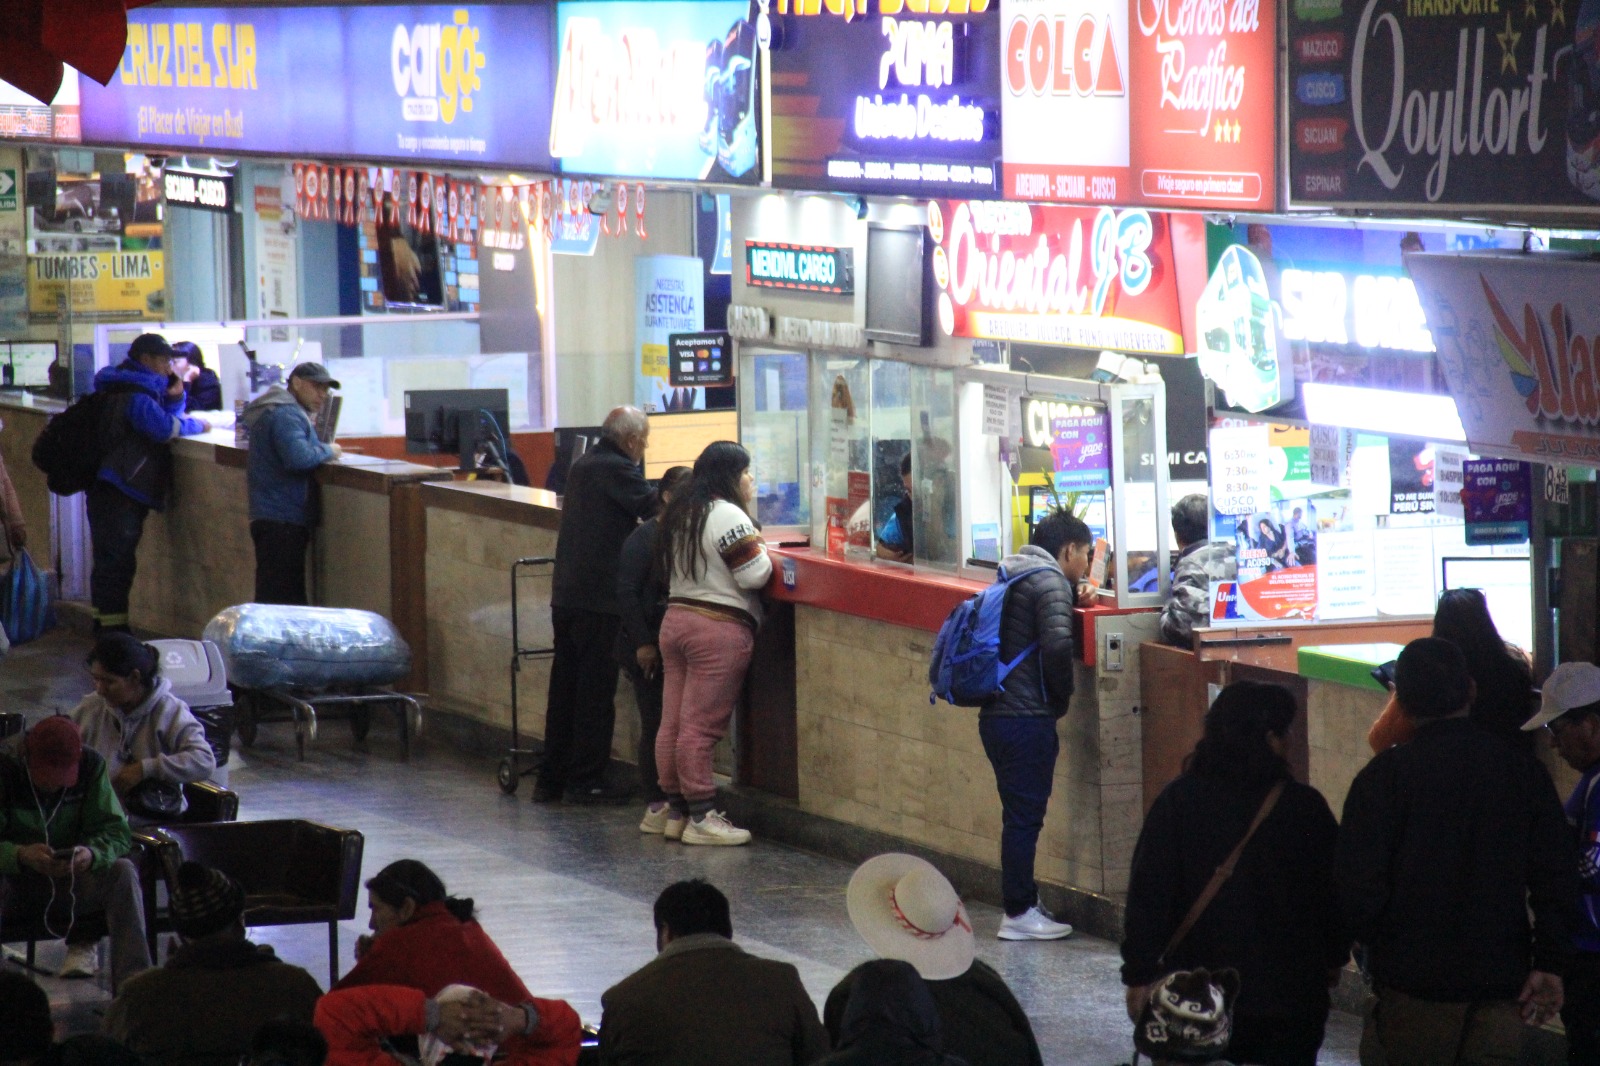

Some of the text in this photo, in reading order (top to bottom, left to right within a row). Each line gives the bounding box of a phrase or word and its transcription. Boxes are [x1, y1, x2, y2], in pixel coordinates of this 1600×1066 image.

[119, 23, 258, 90] CRUZ DEL SUR
[1007, 14, 1126, 97] COLCA
[1302, 41, 1338, 57] MAZUCO
[390, 23, 476, 123] cargo
[1306, 81, 1335, 98] CUSCO
[149, 107, 173, 135] Placer
[175, 107, 187, 136] de
[187, 108, 211, 144] Viajar
[213, 116, 224, 138] en
[1303, 128, 1337, 145] SICUANI
[1015, 172, 1051, 200] AREQUIPA
[1056, 174, 1085, 200] SICUANI
[1091, 177, 1117, 201] CUSCO
[1174, 177, 1195, 195] seguro
[1305, 174, 1341, 192] ESPINAR
[35, 254, 151, 279] TUMBES LIMA
[799, 250, 836, 284] CARGO
[949, 202, 1087, 315] Oriental
[645, 293, 695, 316] ASISTENCIA
[675, 338, 716, 348] Aceptamos
[989, 319, 1029, 338] AREQUIPA
[1037, 323, 1073, 344] JULIACA
[1080, 329, 1105, 347] PUNO
[1114, 332, 1166, 351] VICEVERSA
[679, 350, 695, 359] VISA
[1056, 417, 1079, 428] PAGA
[1061, 430, 1079, 440] CON
[1079, 442, 1103, 463] yape
[1467, 463, 1493, 473] PAGA
[1477, 476, 1496, 486] CON
[1393, 500, 1418, 513] PERÚ
[1394, 493, 1405, 502] YO
[1406, 493, 1417, 501] ME
[1246, 557, 1271, 568] ACOSO
